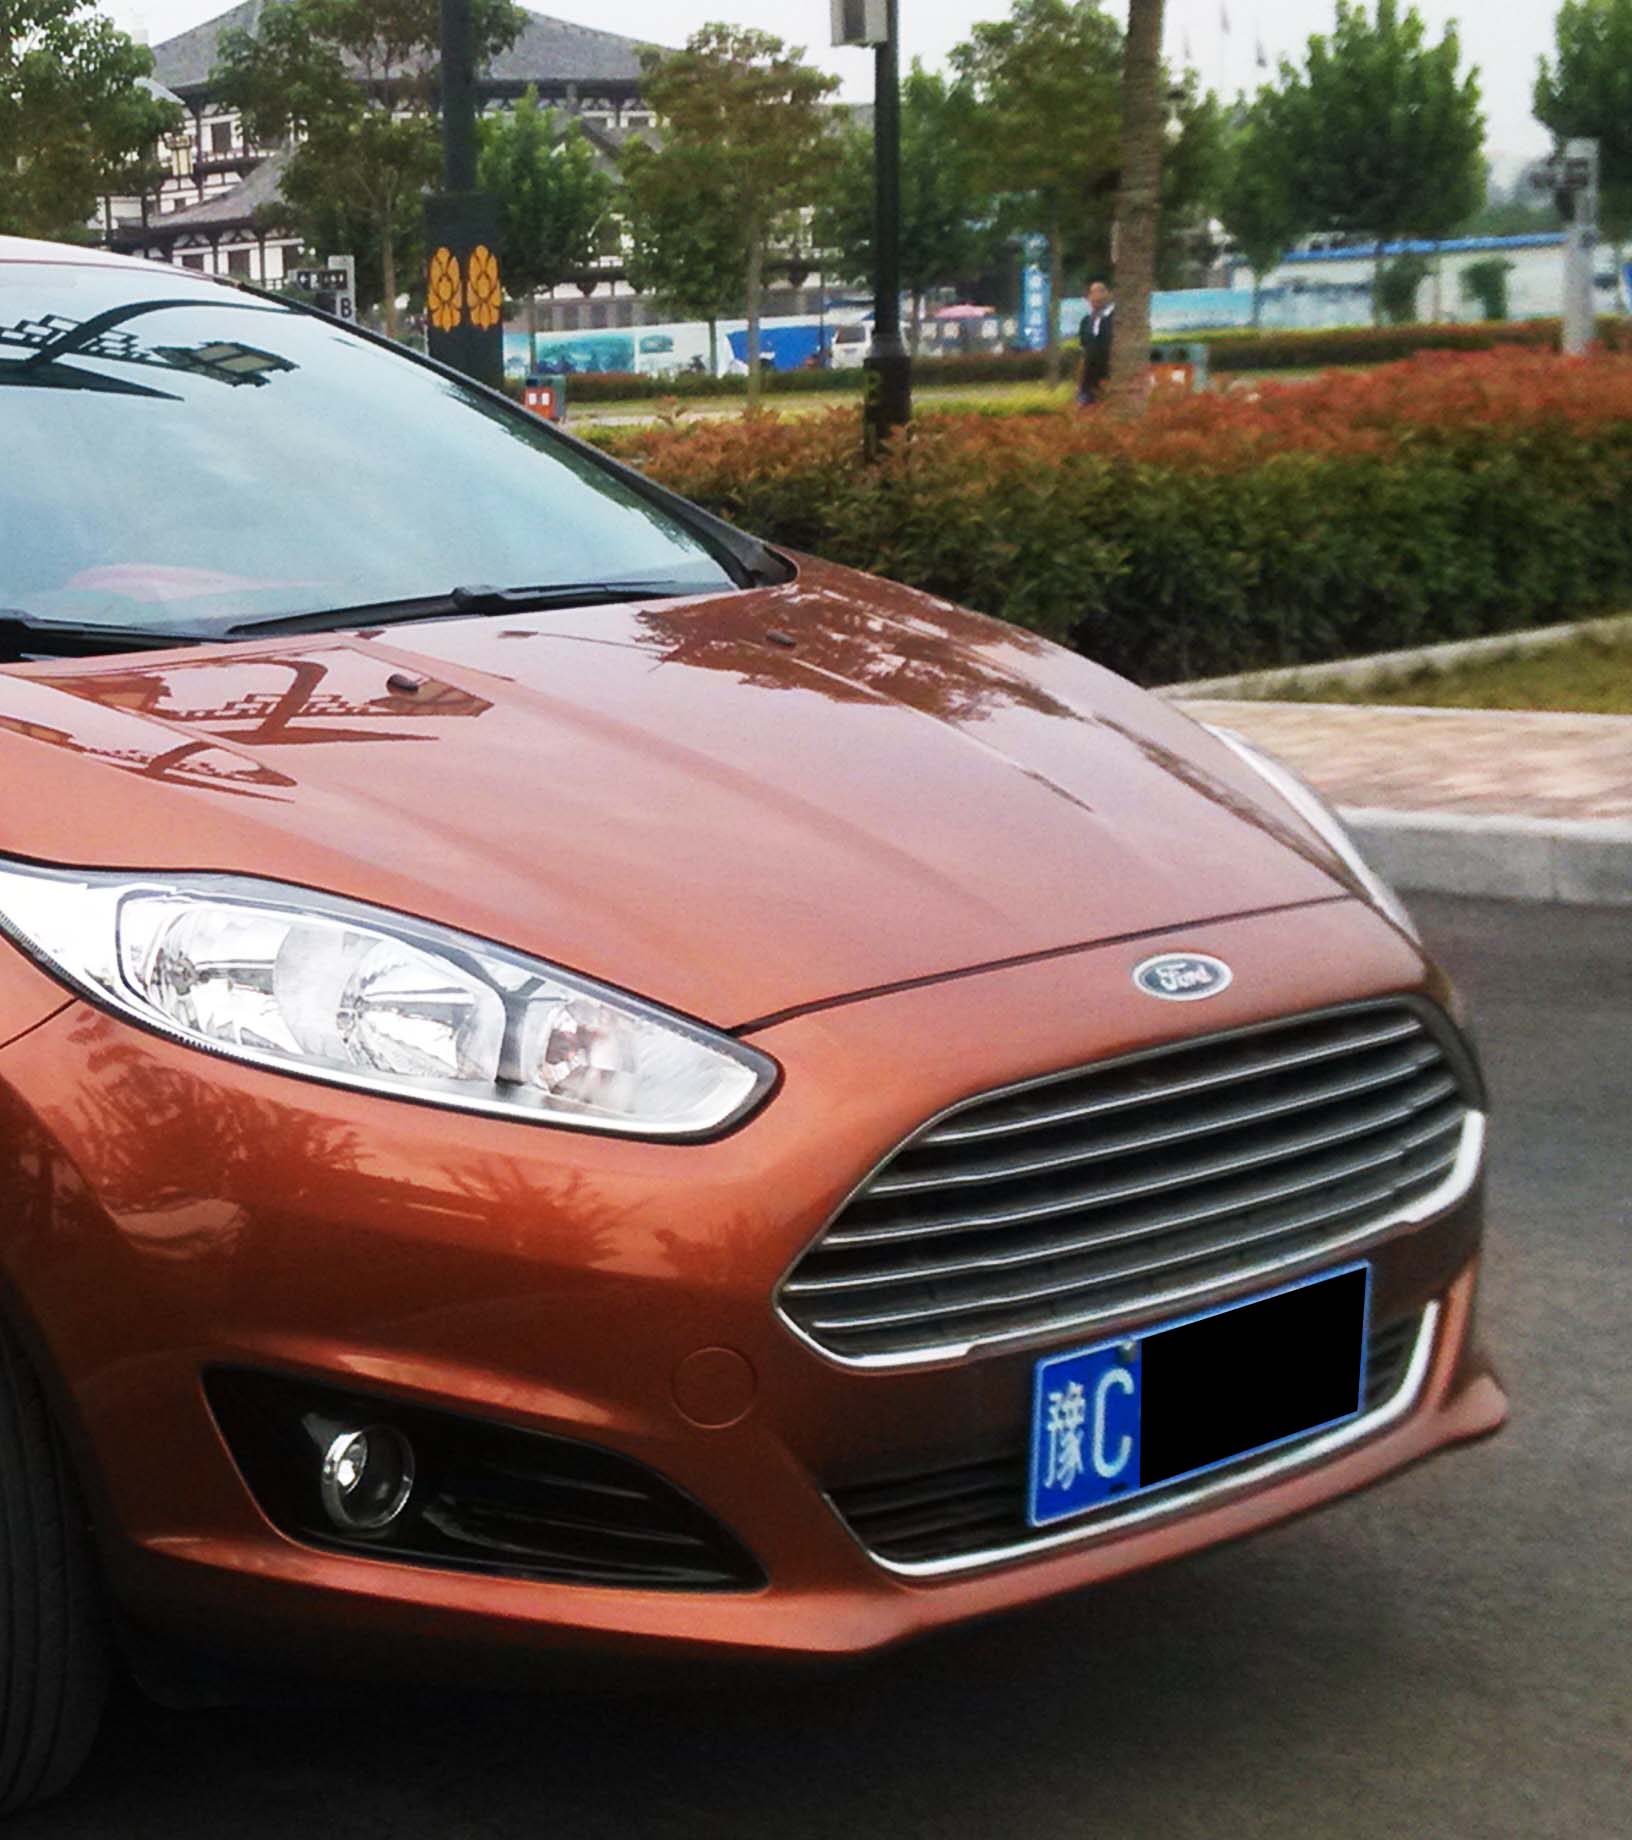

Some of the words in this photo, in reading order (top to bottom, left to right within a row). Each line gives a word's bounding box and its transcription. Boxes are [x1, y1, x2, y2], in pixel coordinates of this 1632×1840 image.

[341, 297, 352, 318] B
[1155, 962, 1213, 991] Ford
[1045, 1368, 1134, 1490] 豫C
